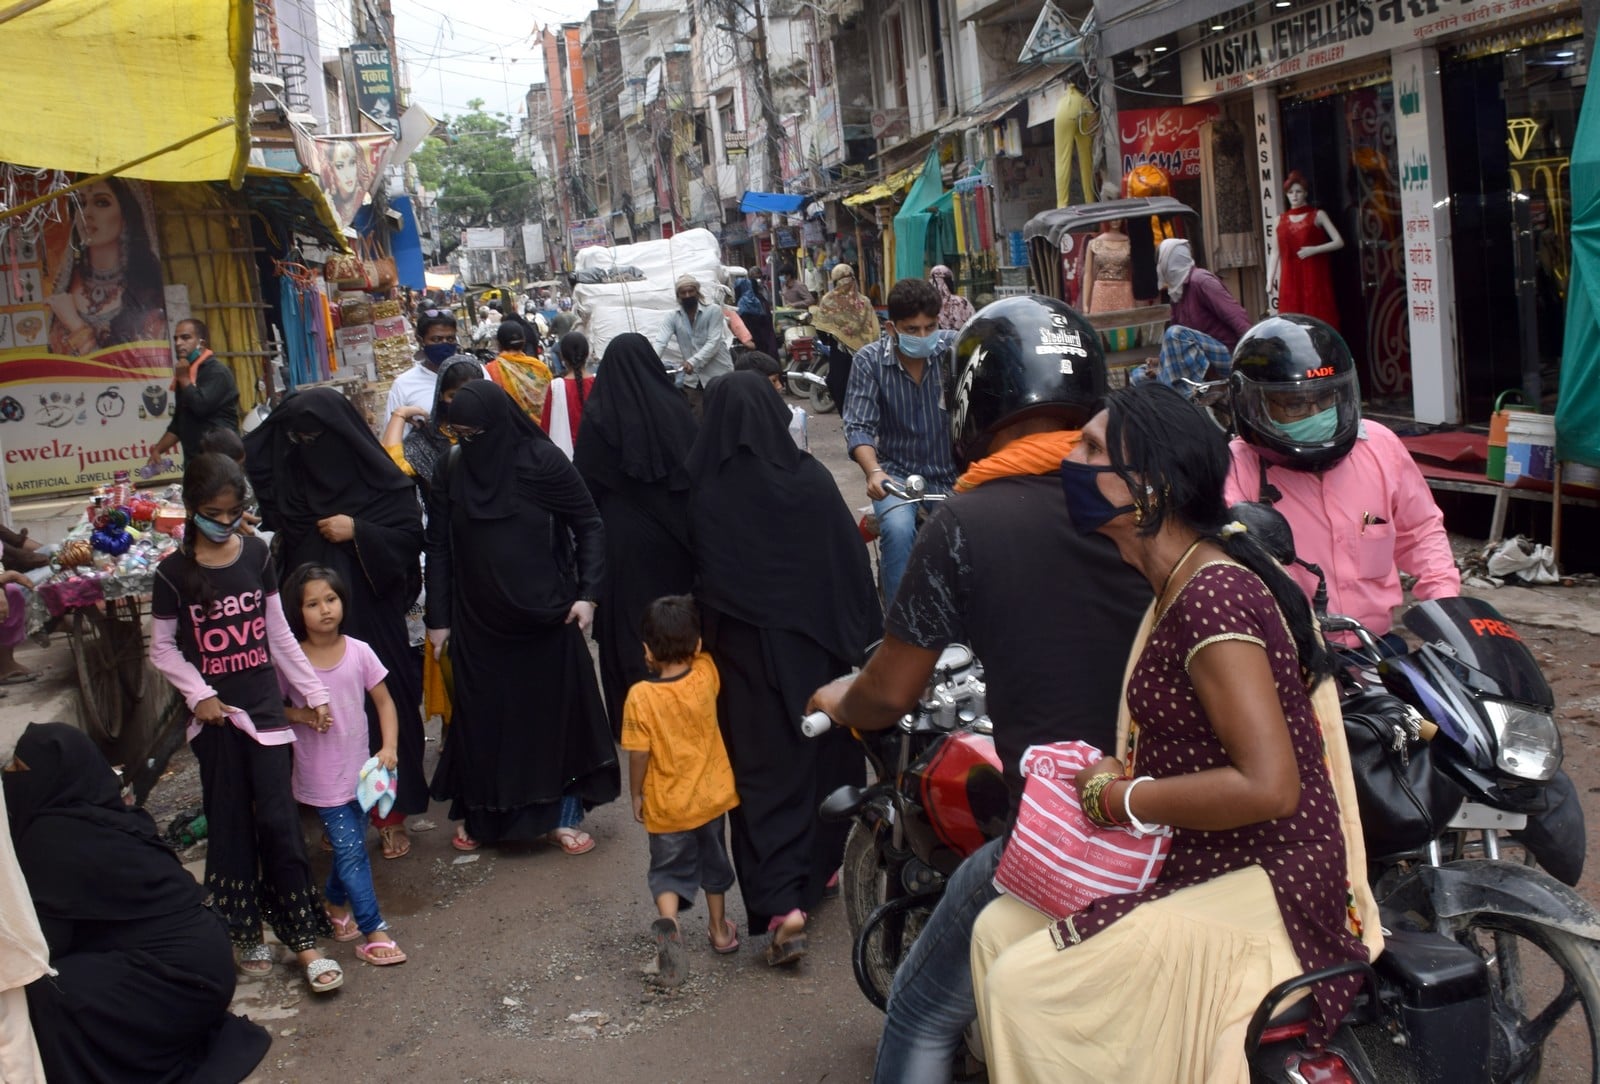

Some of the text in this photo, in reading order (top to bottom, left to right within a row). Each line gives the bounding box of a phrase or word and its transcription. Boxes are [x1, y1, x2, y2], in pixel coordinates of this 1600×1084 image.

[1201, 31, 1262, 82] NASMA
[1268, 3, 1374, 63] JEWELLERS
[1306, 45, 1346, 68] JEWELLERY
[1412, 272, 1432, 294] जेवर
[16, 477, 70, 490] ARTIFICIAL
[75, 468, 132, 484] JEWELLY
[189, 589, 262, 626] peace
[194, 617, 265, 652] love
